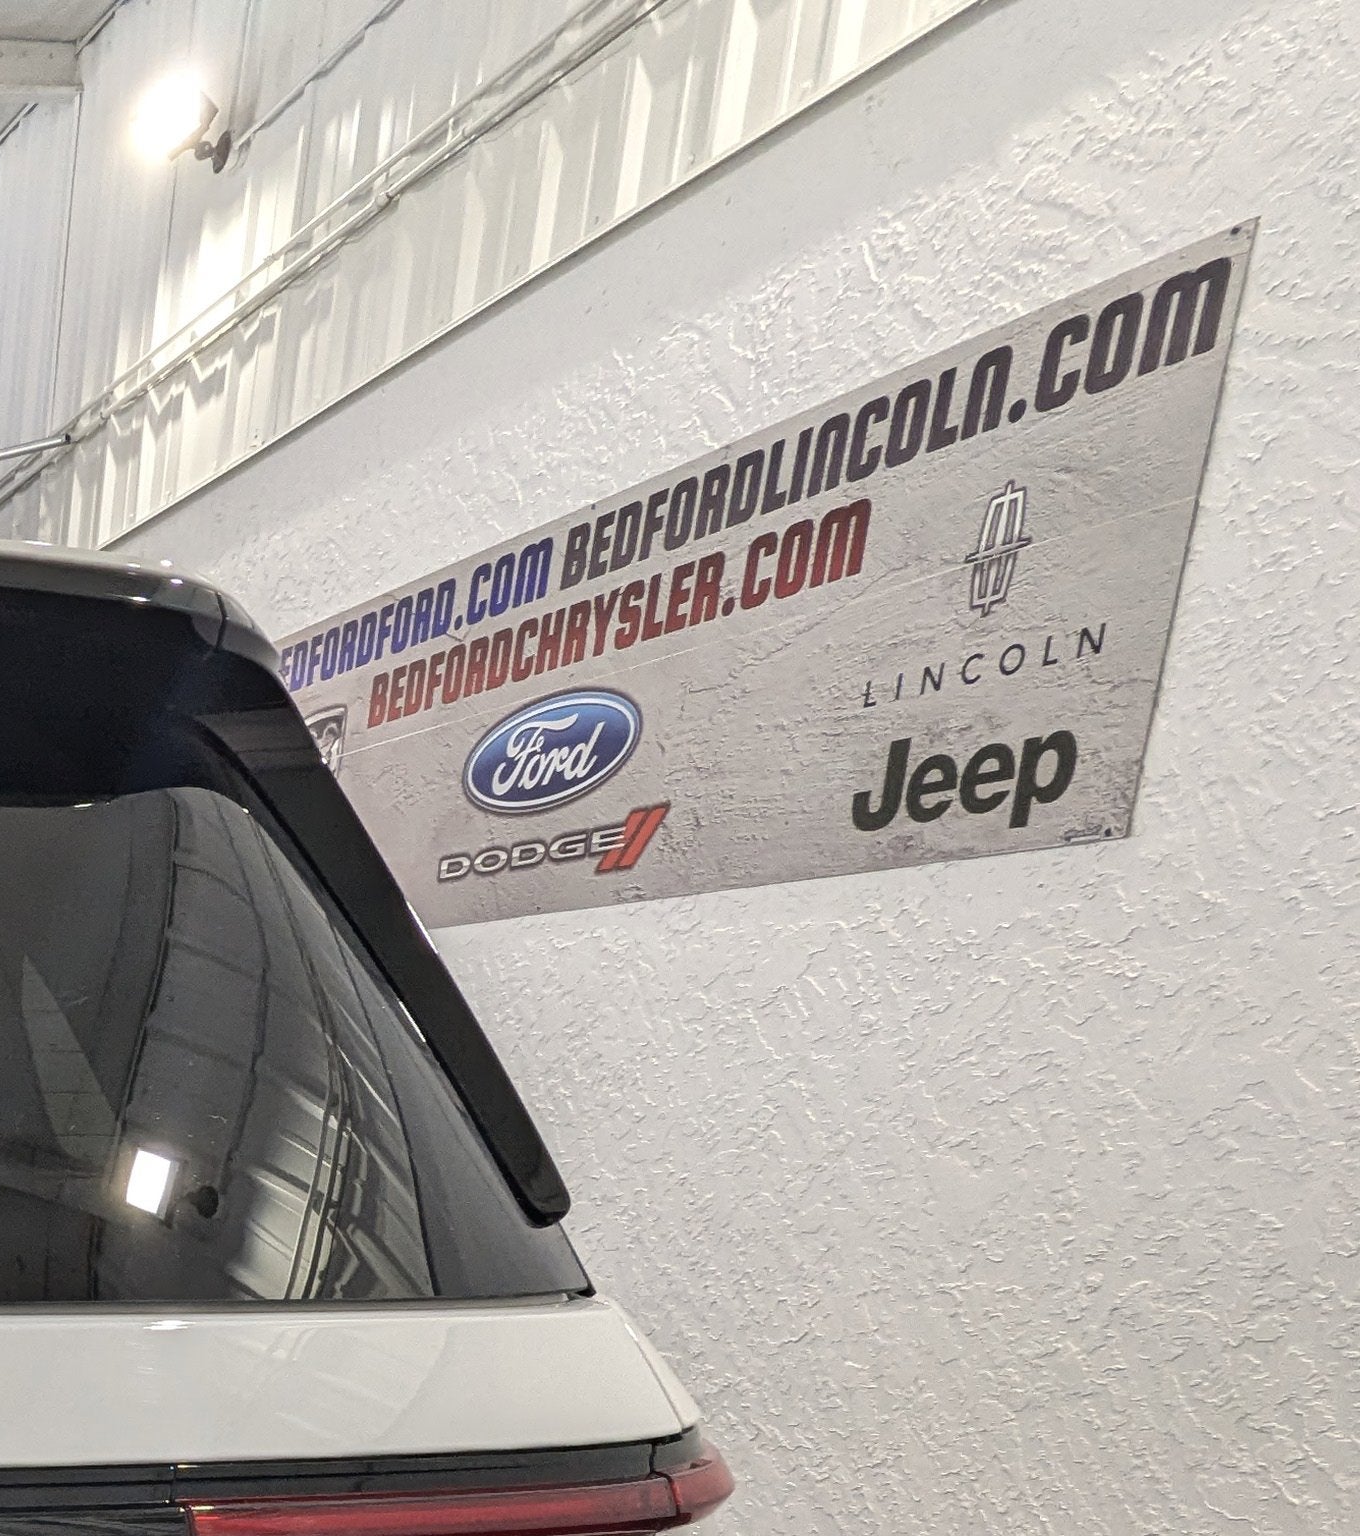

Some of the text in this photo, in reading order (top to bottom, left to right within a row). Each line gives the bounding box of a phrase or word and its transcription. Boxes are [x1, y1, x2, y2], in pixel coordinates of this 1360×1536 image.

[279, 256, 1232, 693] EDFORDFORD.COM BEDFORDLINCOLN.COM
[367, 498, 871, 730] BEDFORDCHRYSLER.COM
[861, 622, 1107, 708] LINCOLN
[491, 712, 606, 796] Ford
[851, 729, 1078, 832] Jeep
[438, 824, 627, 881] DODGE
